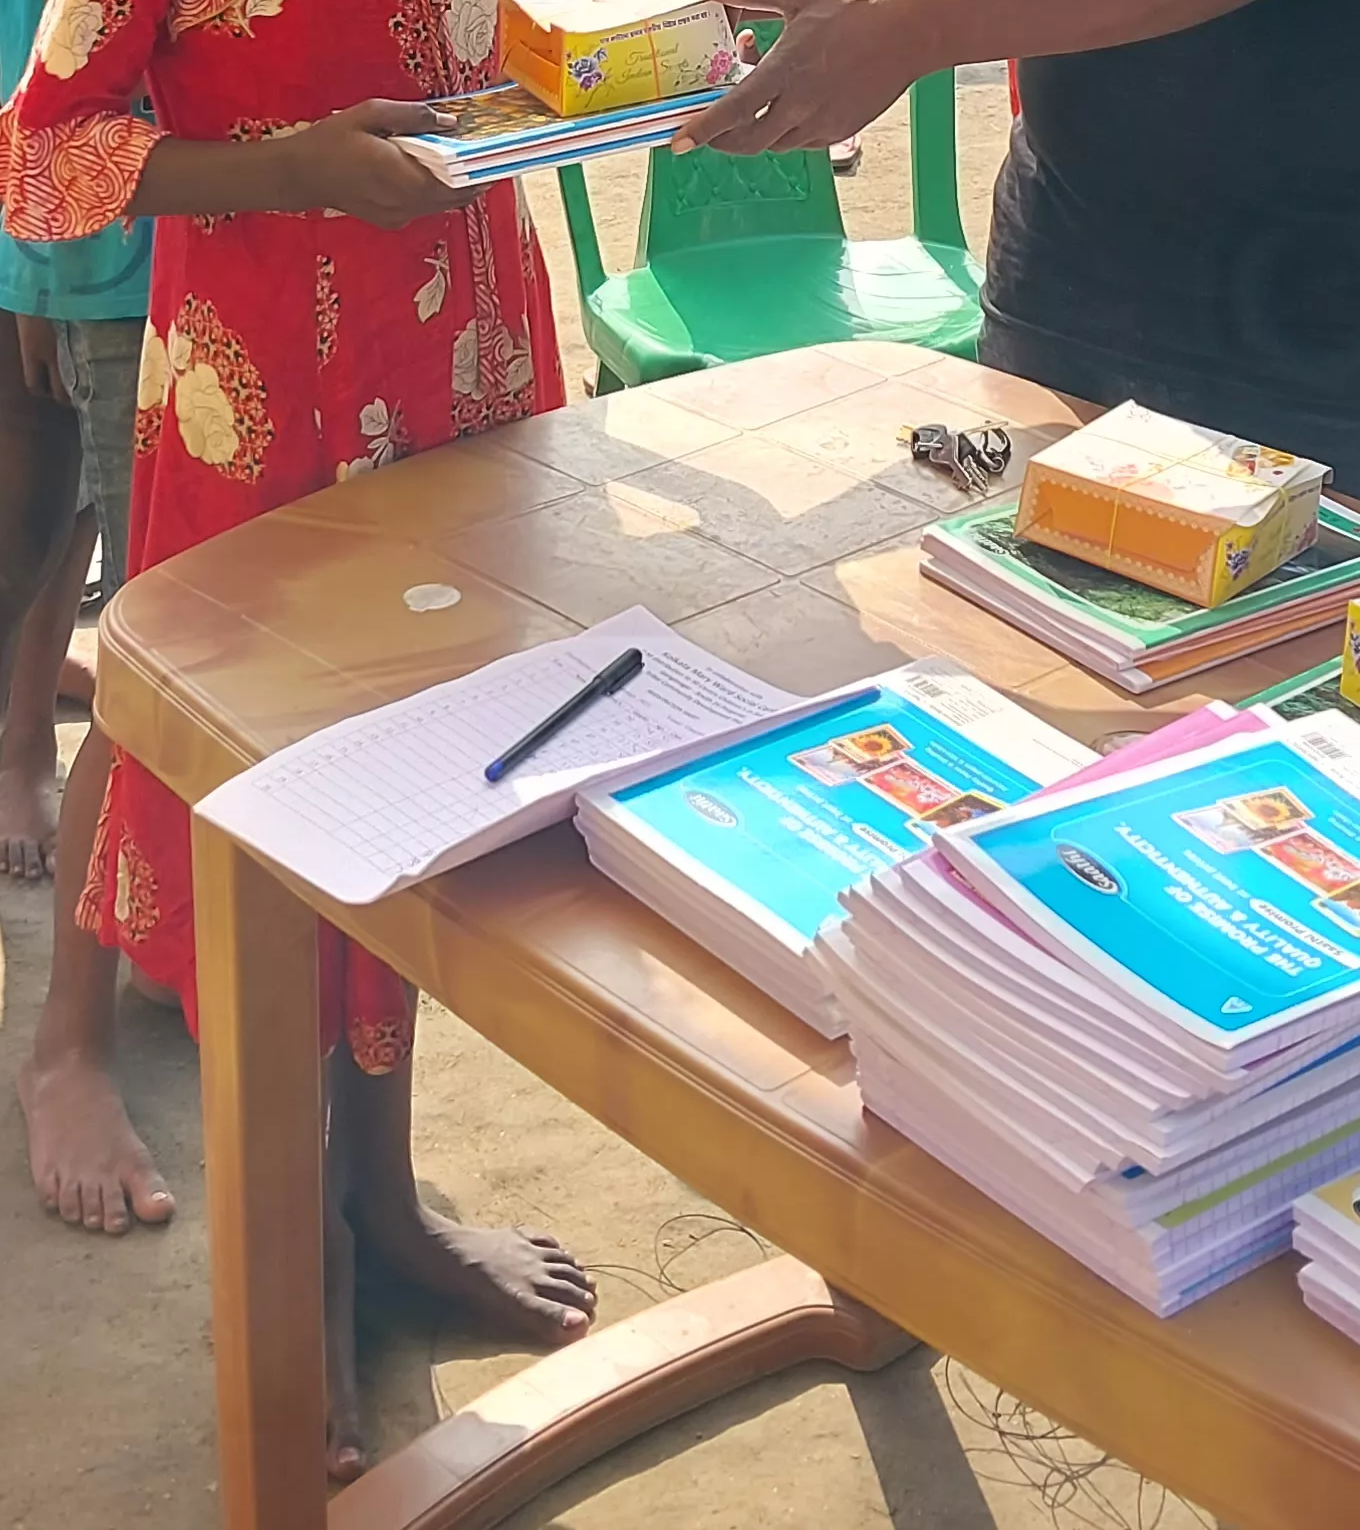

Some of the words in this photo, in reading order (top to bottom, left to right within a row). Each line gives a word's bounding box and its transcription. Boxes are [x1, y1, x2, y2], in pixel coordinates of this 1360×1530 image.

[1060, 848, 1118, 893] Saathi
[1162, 883, 1193, 908] OF
[1192, 900, 1268, 959] PROMISE
[1256, 901, 1306, 938] Promise
[1243, 918, 1323, 971] QUALITY
[1306, 931, 1345, 958] Saathi
[1264, 950, 1303, 977] THE
